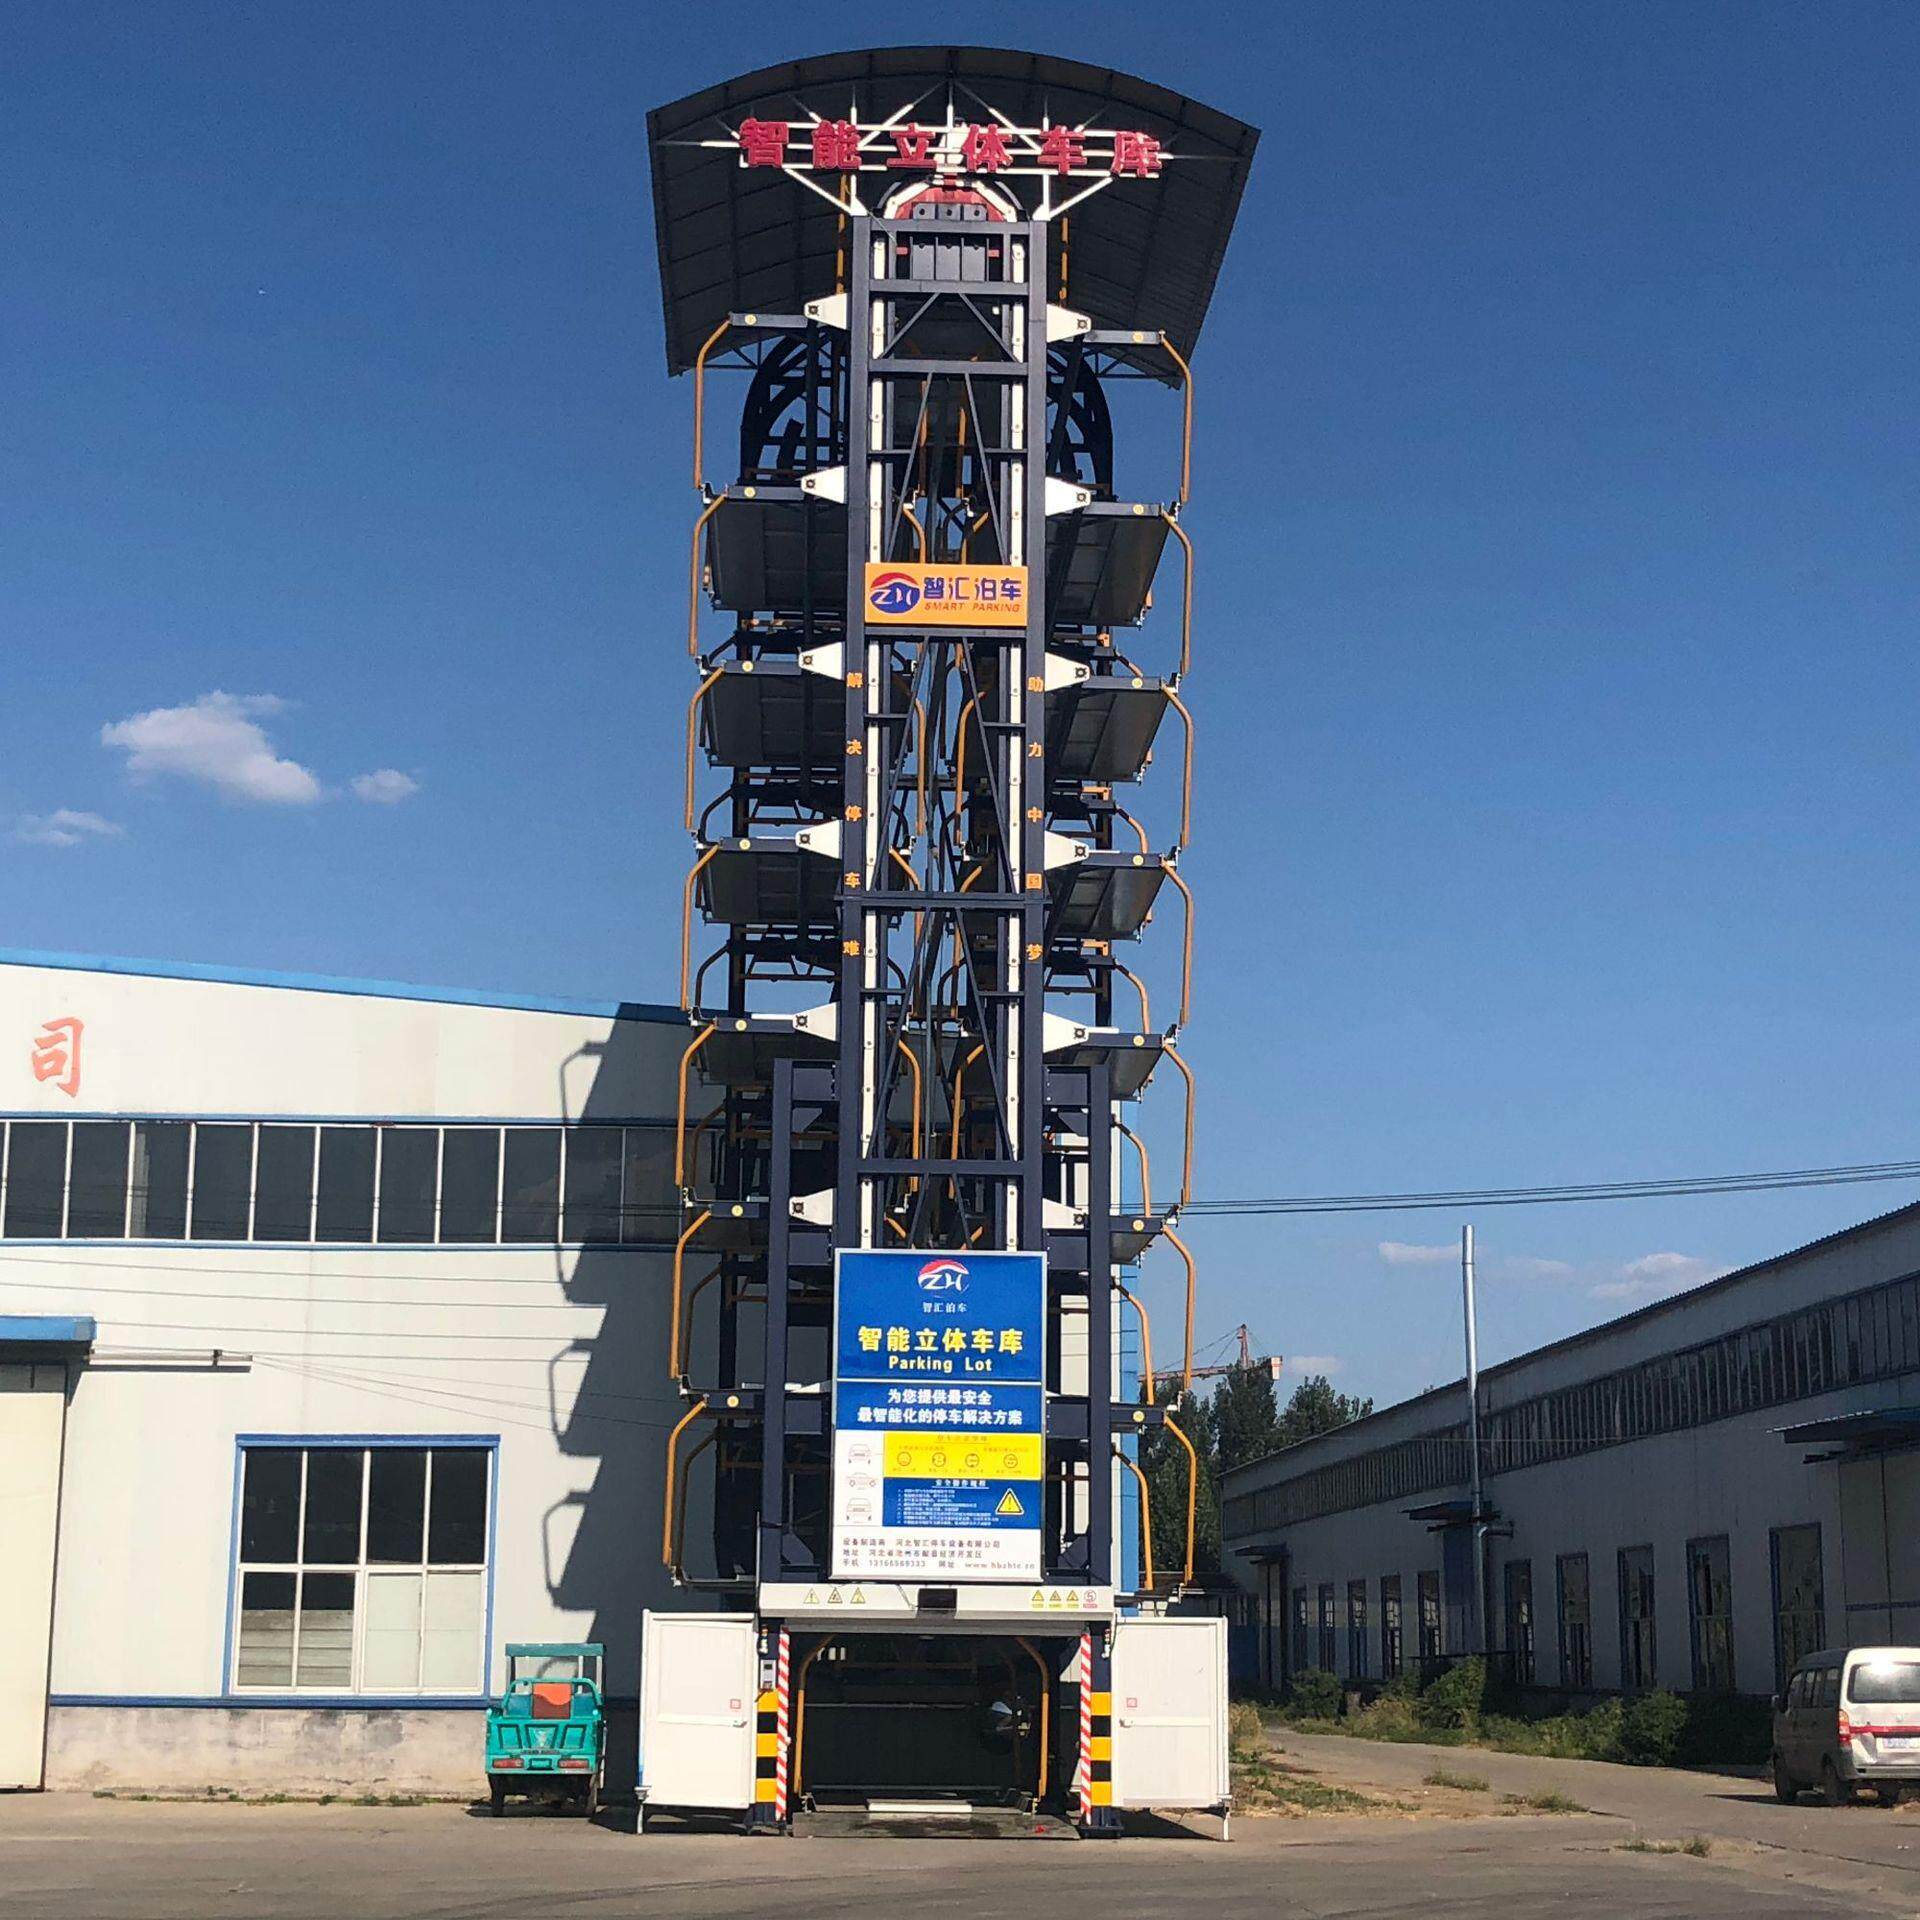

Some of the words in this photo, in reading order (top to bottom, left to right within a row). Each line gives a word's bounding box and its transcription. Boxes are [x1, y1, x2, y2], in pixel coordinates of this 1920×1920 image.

[739, 117, 1163, 178] 智能立体车库
[923, 576, 1022, 601] 智汇泊车
[924, 602, 965, 611] SMART
[972, 603, 1021, 613] PARKING
[842, 671, 863, 957] 解决停车难
[1026, 675, 1045, 961] 助力中国梦
[31, 1016, 85, 1098] 司
[922, 1301, 968, 1313] 智汇泊车
[858, 1325, 1024, 1355] 智能立体车库
[889, 1357, 953, 1373] Parking
[965, 1357, 992, 1371] Lot
[887, 1388, 993, 1406] 为您提供最安全
[857, 1406, 1023, 1426] 最智能化的停车解决方案
